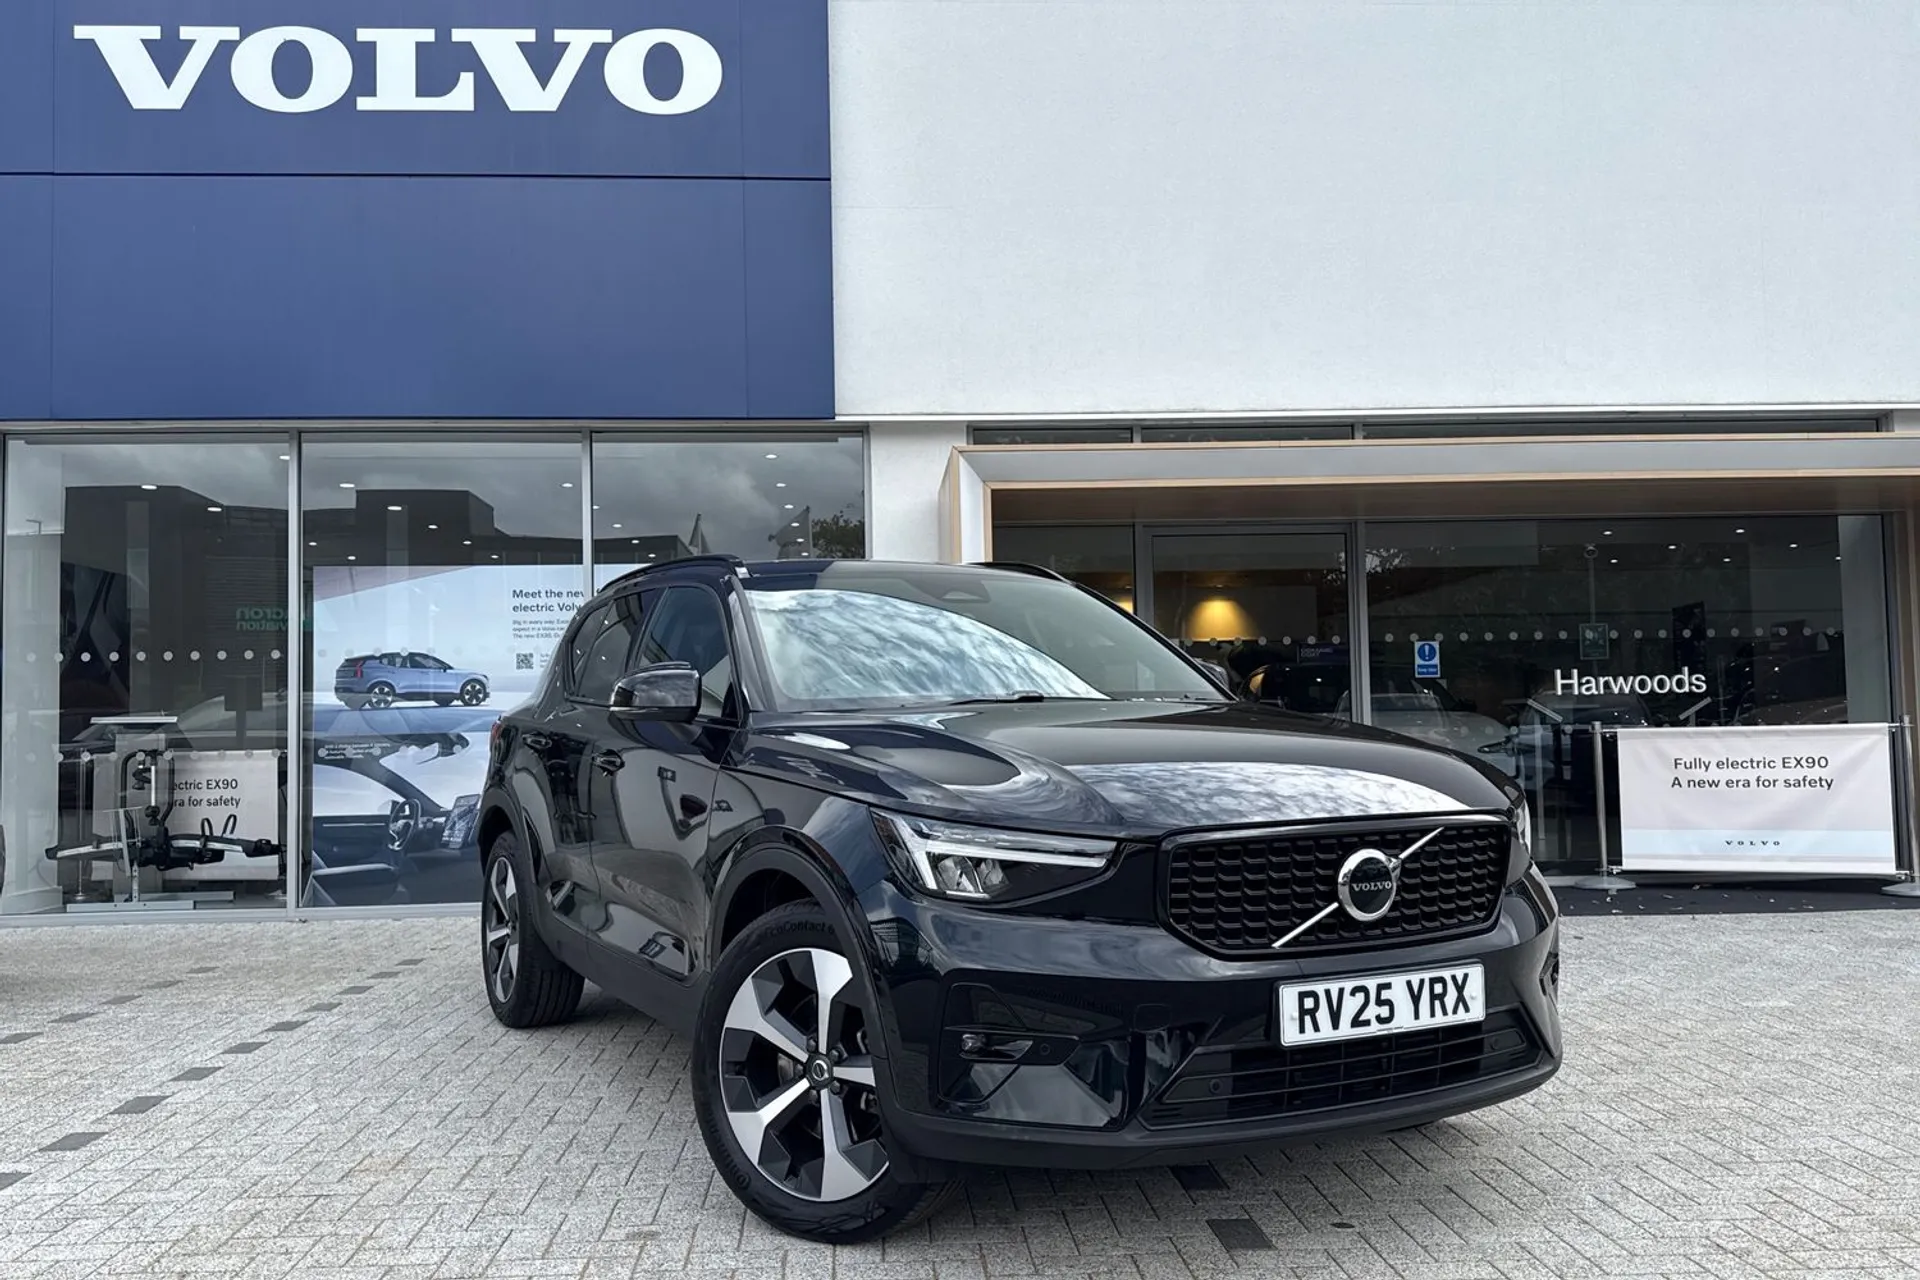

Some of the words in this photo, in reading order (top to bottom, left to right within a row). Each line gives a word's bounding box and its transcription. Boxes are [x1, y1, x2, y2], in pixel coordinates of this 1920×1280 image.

[73, 24, 723, 115] VOLVO
[512, 589, 542, 599] Meet
[545, 589, 564, 598] the
[512, 602, 555, 612] electric
[557, 602, 581, 612] Volv
[1555, 666, 1707, 696] Harwoods
[1673, 757, 1711, 772] Fully
[1715, 756, 1777, 770] electric
[1781, 756, 1829, 769] EX90
[174, 779, 203, 790] ectric
[206, 778, 238, 790] EX90
[1671, 776, 1682, 788] A
[1687, 778, 1720, 788] new
[1725, 778, 1750, 788] era
[1756, 775, 1779, 788] for
[1783, 775, 1834, 791] safety
[174, 798, 185, 808] ra
[188, 795, 203, 807] for
[206, 795, 241, 808] safety
[1351, 880, 1392, 892] VOLVO
[764, 920, 825, 937] EcoContact
[1297, 982, 1395, 1035] RV25
[1406, 972, 1471, 1021] YRX
